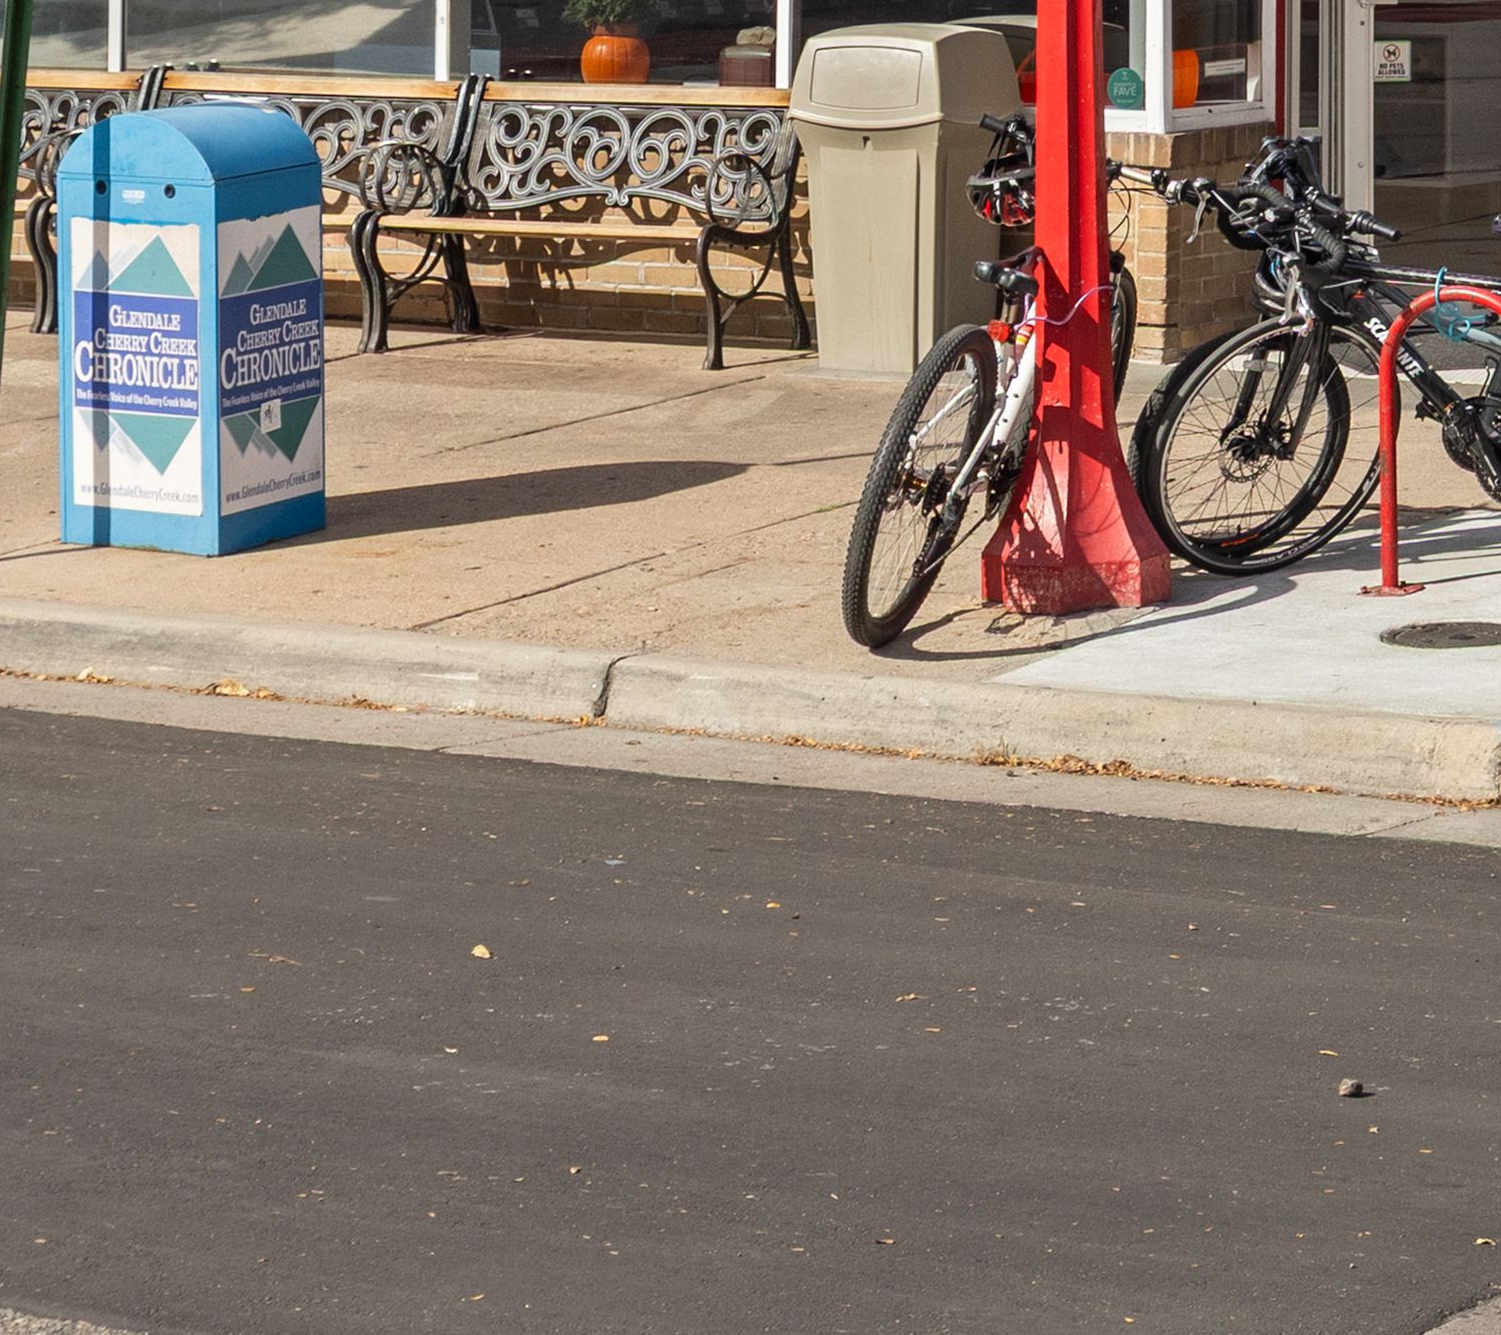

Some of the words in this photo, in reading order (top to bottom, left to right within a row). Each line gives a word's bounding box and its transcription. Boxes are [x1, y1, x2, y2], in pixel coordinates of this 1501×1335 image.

[108, 304, 181, 332] GLENDALE
[250, 298, 307, 326] GLENDALE
[94, 327, 149, 353] CHERRY
[149, 331, 197, 357] CREEK
[237, 329, 281, 352] CHERRY
[282, 319, 319, 342] CREEK
[74, 339, 198, 391] CHRONICLE
[220, 338, 321, 391] CHRONICLE
